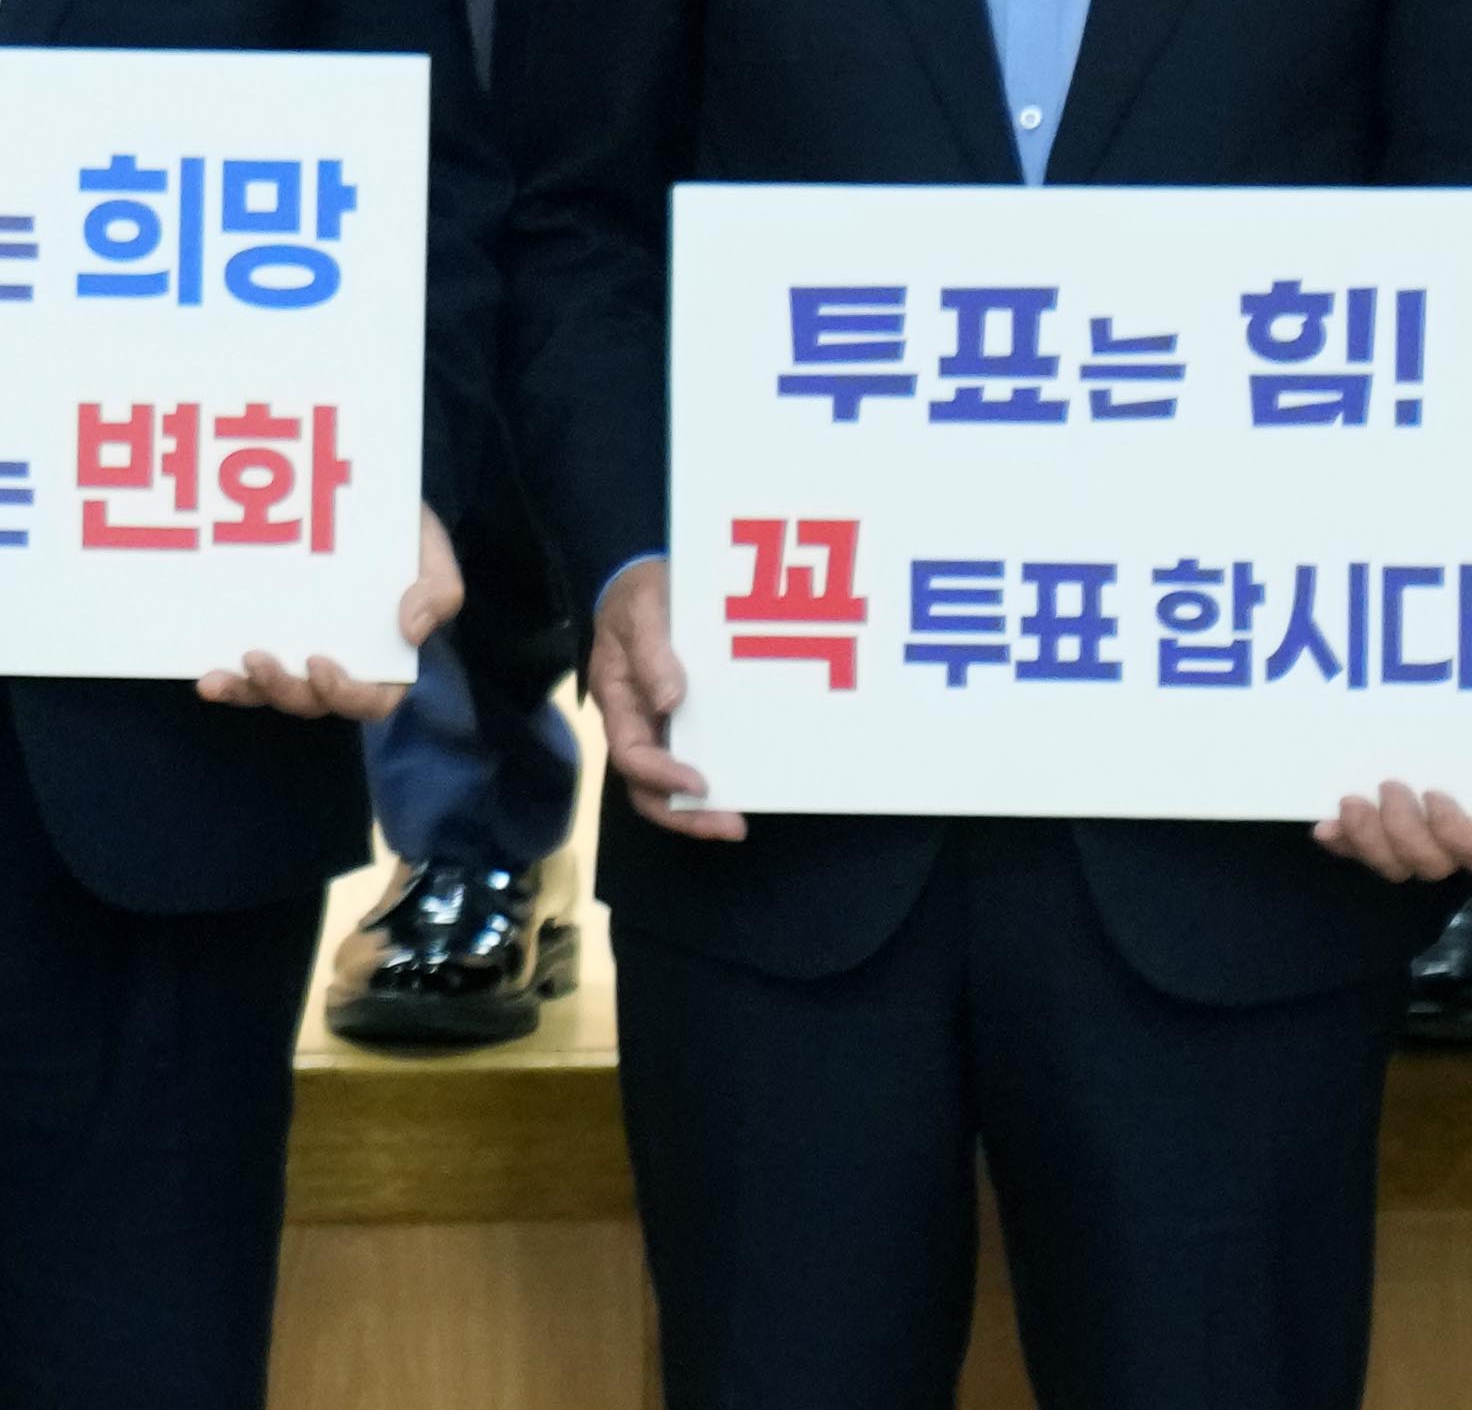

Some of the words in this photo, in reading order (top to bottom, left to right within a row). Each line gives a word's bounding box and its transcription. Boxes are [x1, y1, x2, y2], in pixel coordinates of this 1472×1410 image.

[75, 154, 358, 309] 희망
[777, 285, 1187, 424] 투표는
[1240, 279, 1427, 428] 힘!
[75, 402, 352, 555] 변화
[725, 518, 869, 692] 꼭
[903, 559, 1123, 689] 투표
[1151, 558, 1472, 691] 합시다
